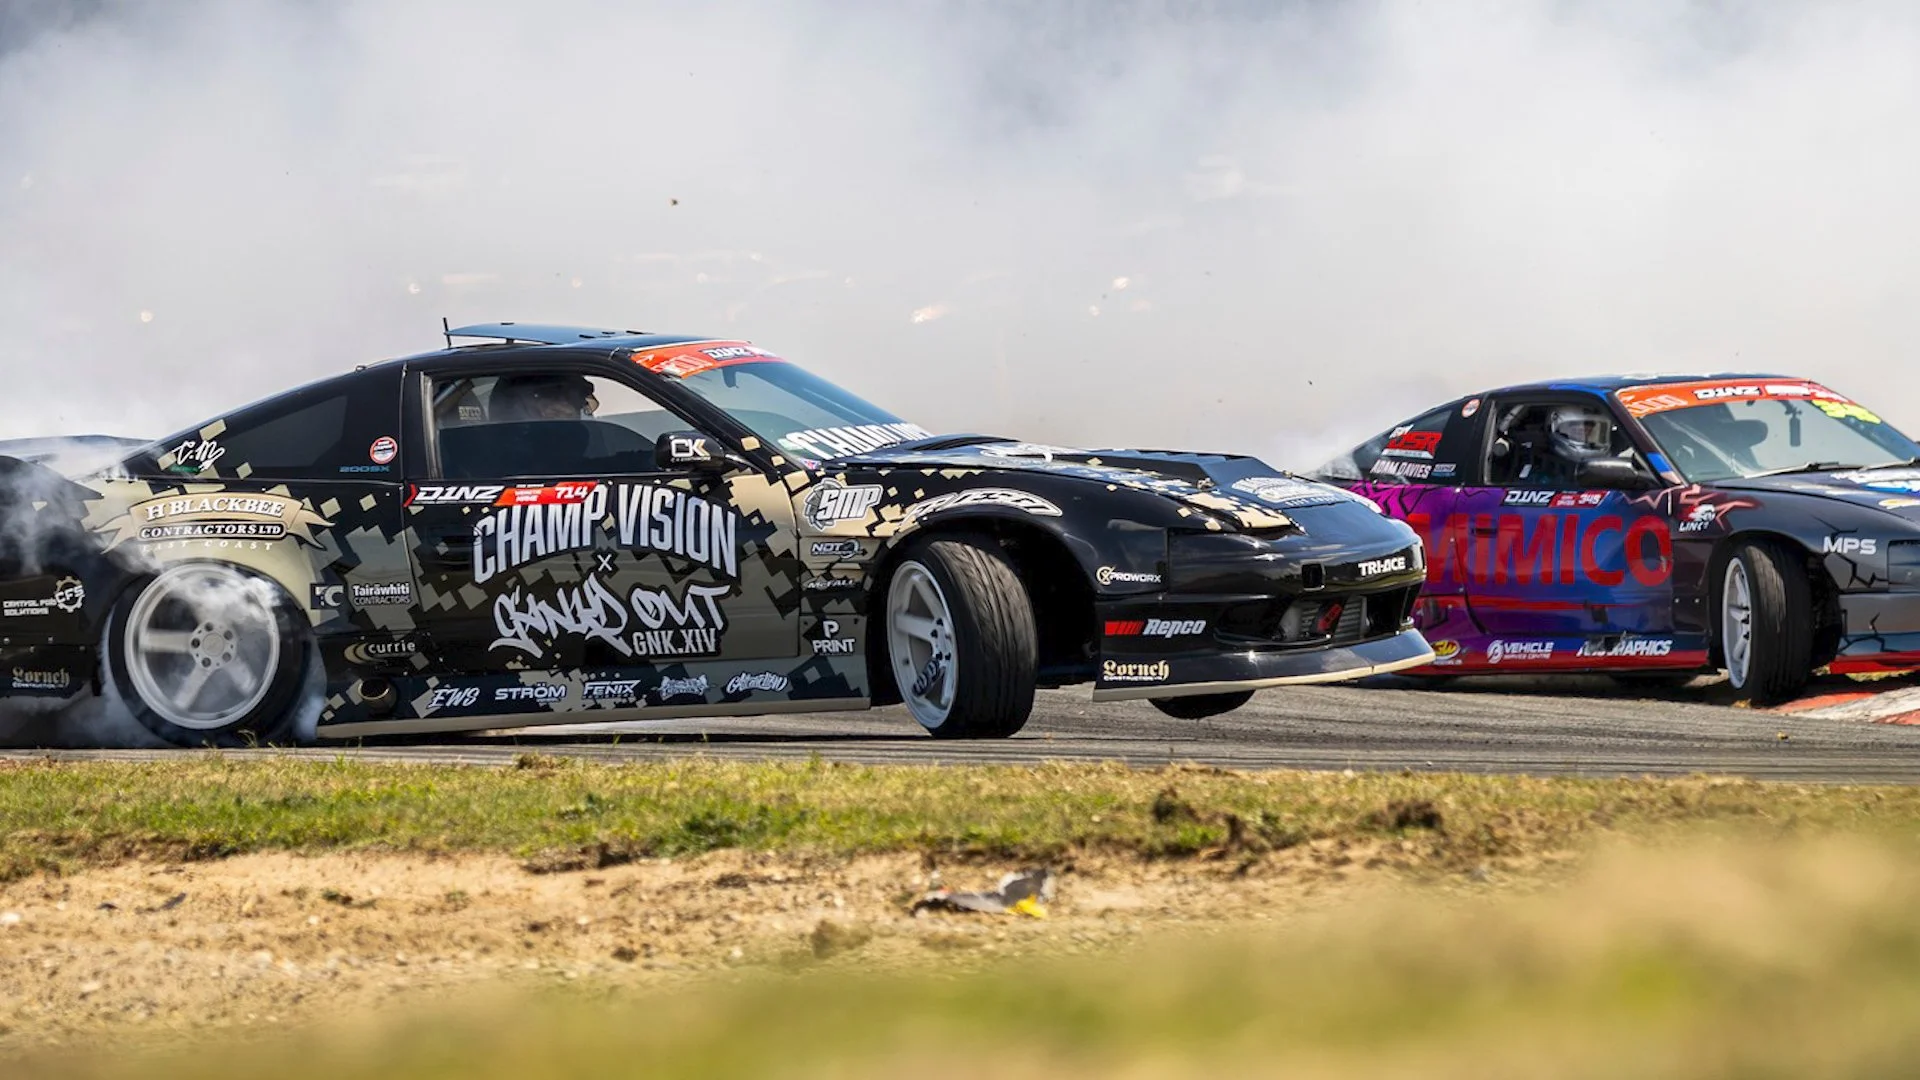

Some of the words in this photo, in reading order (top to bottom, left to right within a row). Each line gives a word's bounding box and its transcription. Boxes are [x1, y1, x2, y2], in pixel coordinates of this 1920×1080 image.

[1370, 460, 1400, 475] ADAM
[1398, 462, 1432, 479] DAVIES
[415, 486, 505, 501] D1NZ
[555, 486, 589, 500] 714
[146, 504, 168, 521] H
[168, 497, 286, 518] BLACKBEE
[816, 488, 881, 521] SMP
[140, 524, 257, 539] CONTRACTORS
[258, 525, 281, 535] LTD
[473, 484, 609, 584] CHAMP
[617, 484, 737, 577] VISION
[204, 540, 273, 551] COAST
[1823, 536, 1877, 555] MPS
[55, 585, 84, 603] CFS
[353, 595, 411, 606] CONTRACTORS
[1143, 619, 1206, 638] Repco
[368, 640, 416, 654] currie
[632, 628, 718, 655] GNK.XIV
[812, 639, 855, 653] PRINT
[1504, 642, 1554, 654] VEHICLE
[494, 682, 567, 700] STRÖM
[583, 680, 641, 695] FENIX
